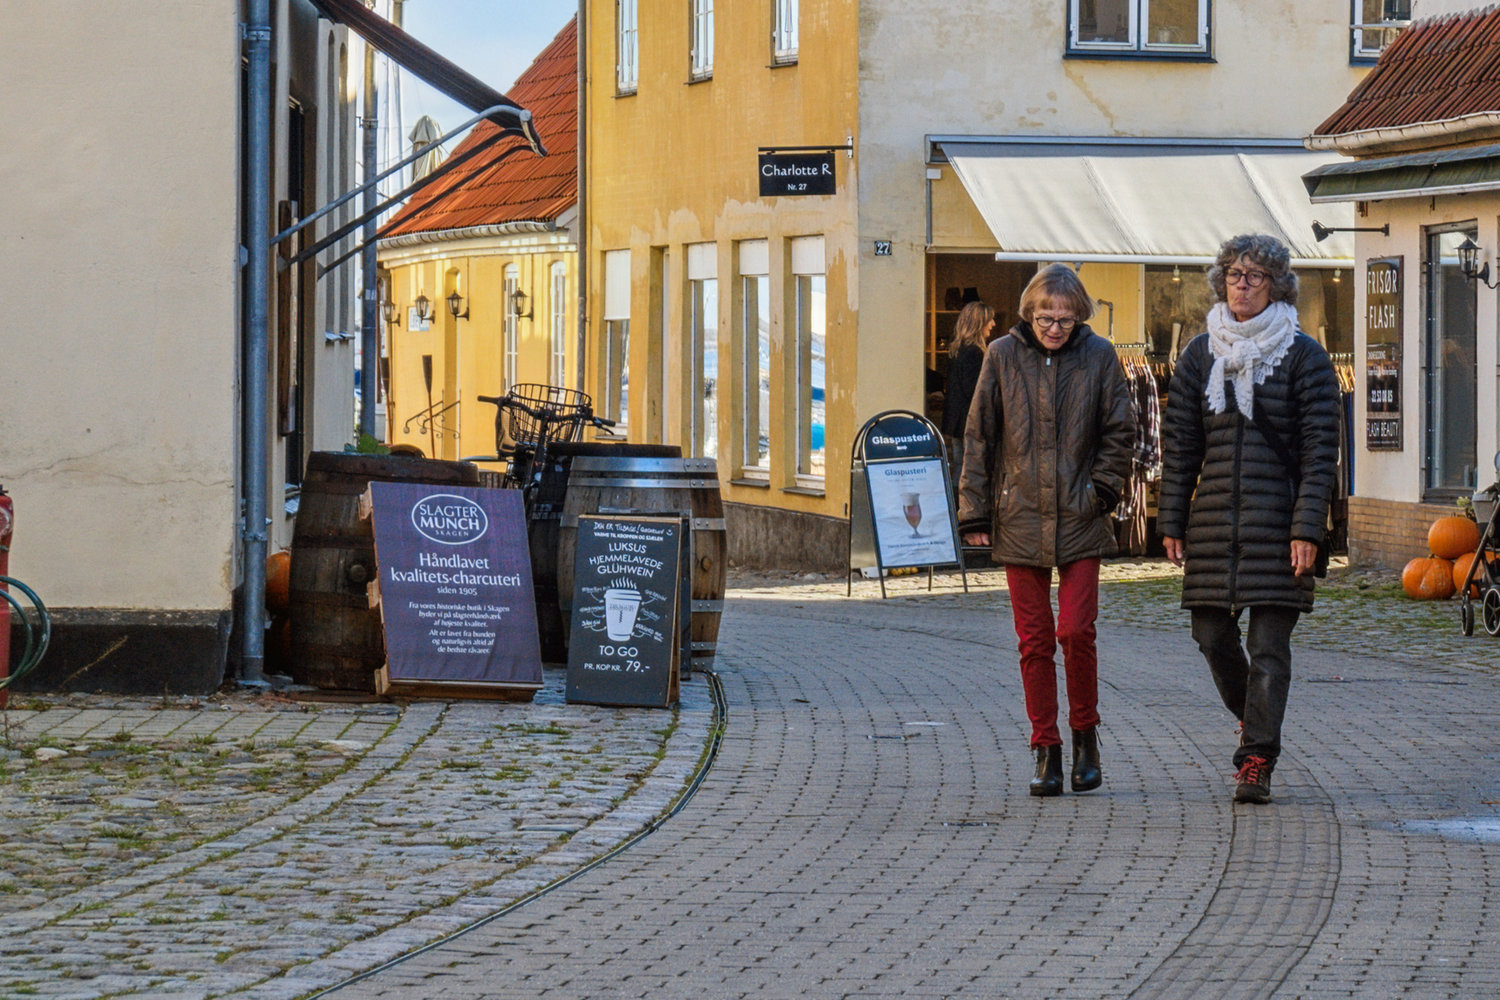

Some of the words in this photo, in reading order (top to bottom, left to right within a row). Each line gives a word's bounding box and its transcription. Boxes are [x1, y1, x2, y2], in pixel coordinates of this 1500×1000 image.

[762, 164, 818, 176] Charlotte
[822, 163, 832, 175] R
[877, 242, 890, 254] 27
[1368, 270, 1397, 295] FRISØR
[1370, 305, 1395, 328] FLASH
[1381, 422, 1398, 437] BEAUTY
[872, 432, 931, 445] Glaspusteri
[884, 466, 927, 477] Glaspusteri
[420, 504, 478, 518] SLAGTER
[420, 518, 480, 530] MUNCH
[609, 542, 647, 554] LUKSUS
[420, 553, 490, 569] Håndlavet
[589, 554, 663, 570] HJEMMELAVEDE
[597, 563, 654, 578] GLÜHWEIN
[459, 588, 477, 596] 1905
[419, 610, 436, 618] byder
[487, 605, 510, 613] Skagen
[599, 645, 614, 656] TO
[617, 646, 638, 657] GO
[626, 660, 650, 672] 79.-
